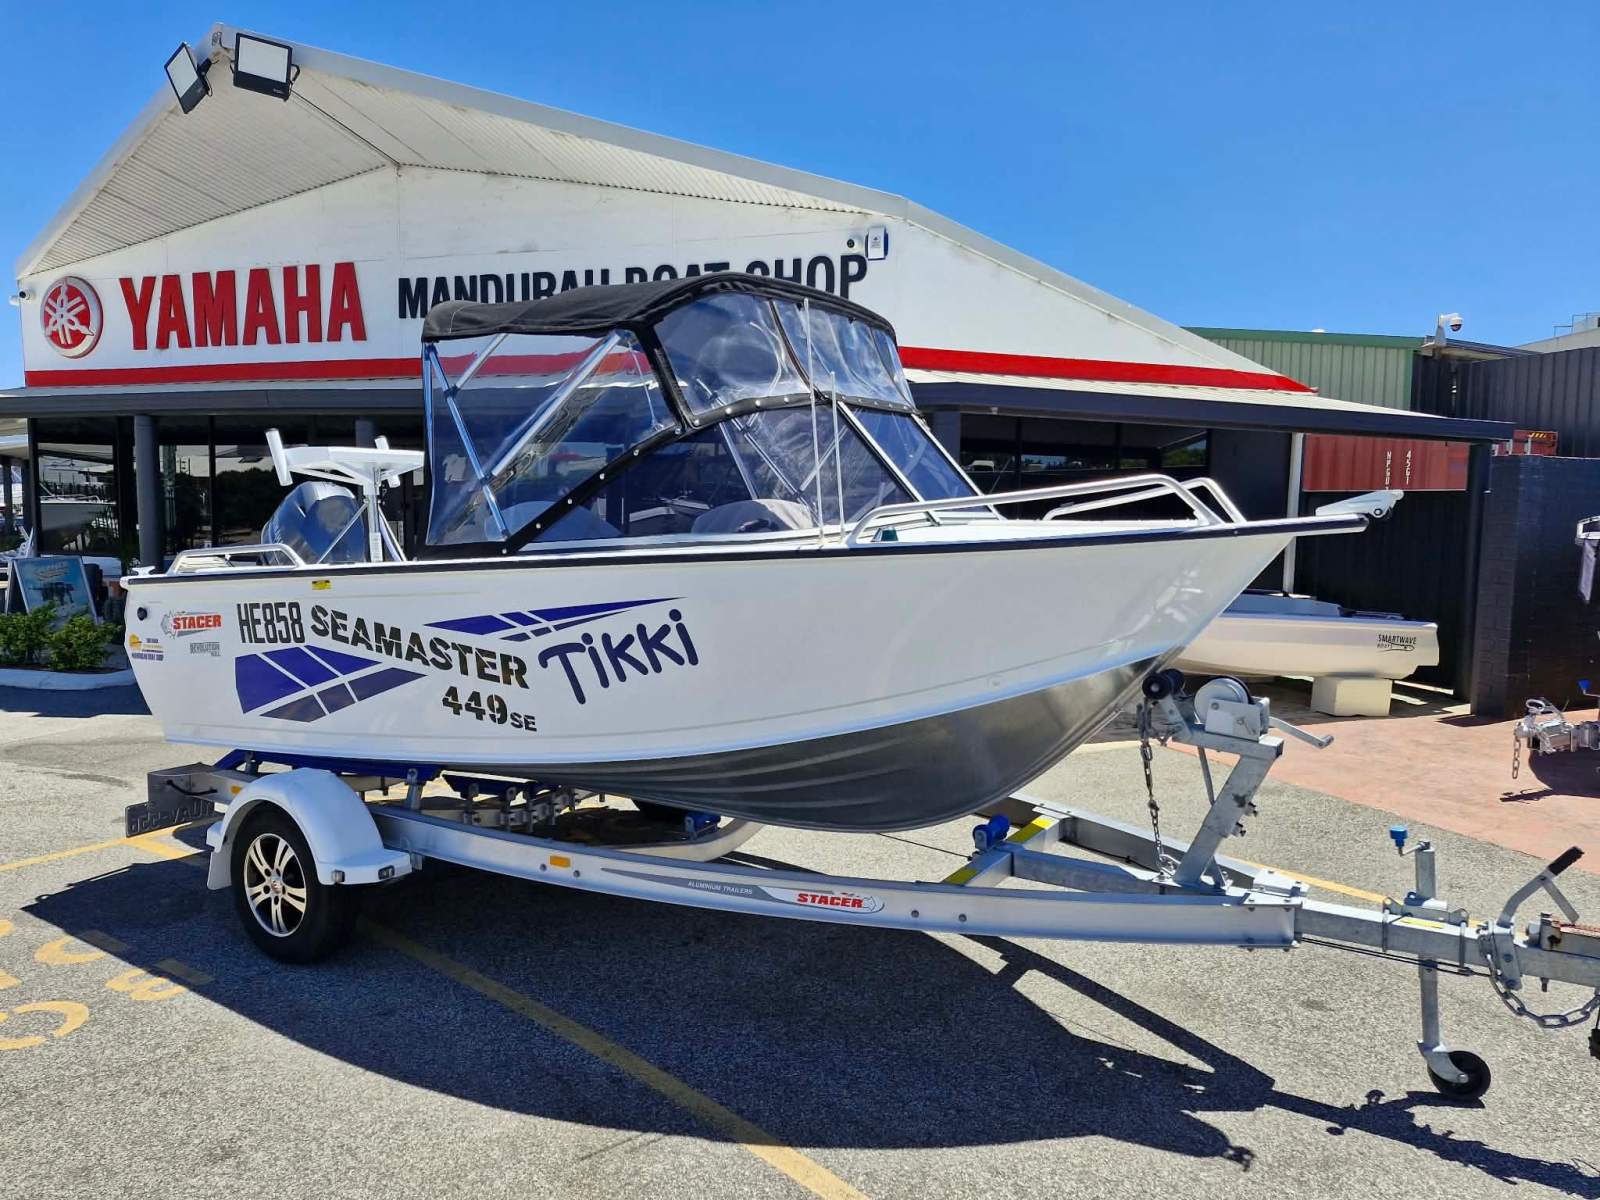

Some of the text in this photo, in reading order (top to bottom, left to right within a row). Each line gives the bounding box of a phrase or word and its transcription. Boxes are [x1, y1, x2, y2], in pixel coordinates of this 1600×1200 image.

[118, 262, 367, 350] YAMAHA
[173, 614, 222, 630] STACER
[236, 602, 305, 644] HE858
[310, 604, 530, 690] SEAMASTER
[1377, 633, 1417, 645] SMARTWAVE
[688, 881, 752, 895] ALUMINIUM TRAILERS
[797, 893, 863, 908] STACER
